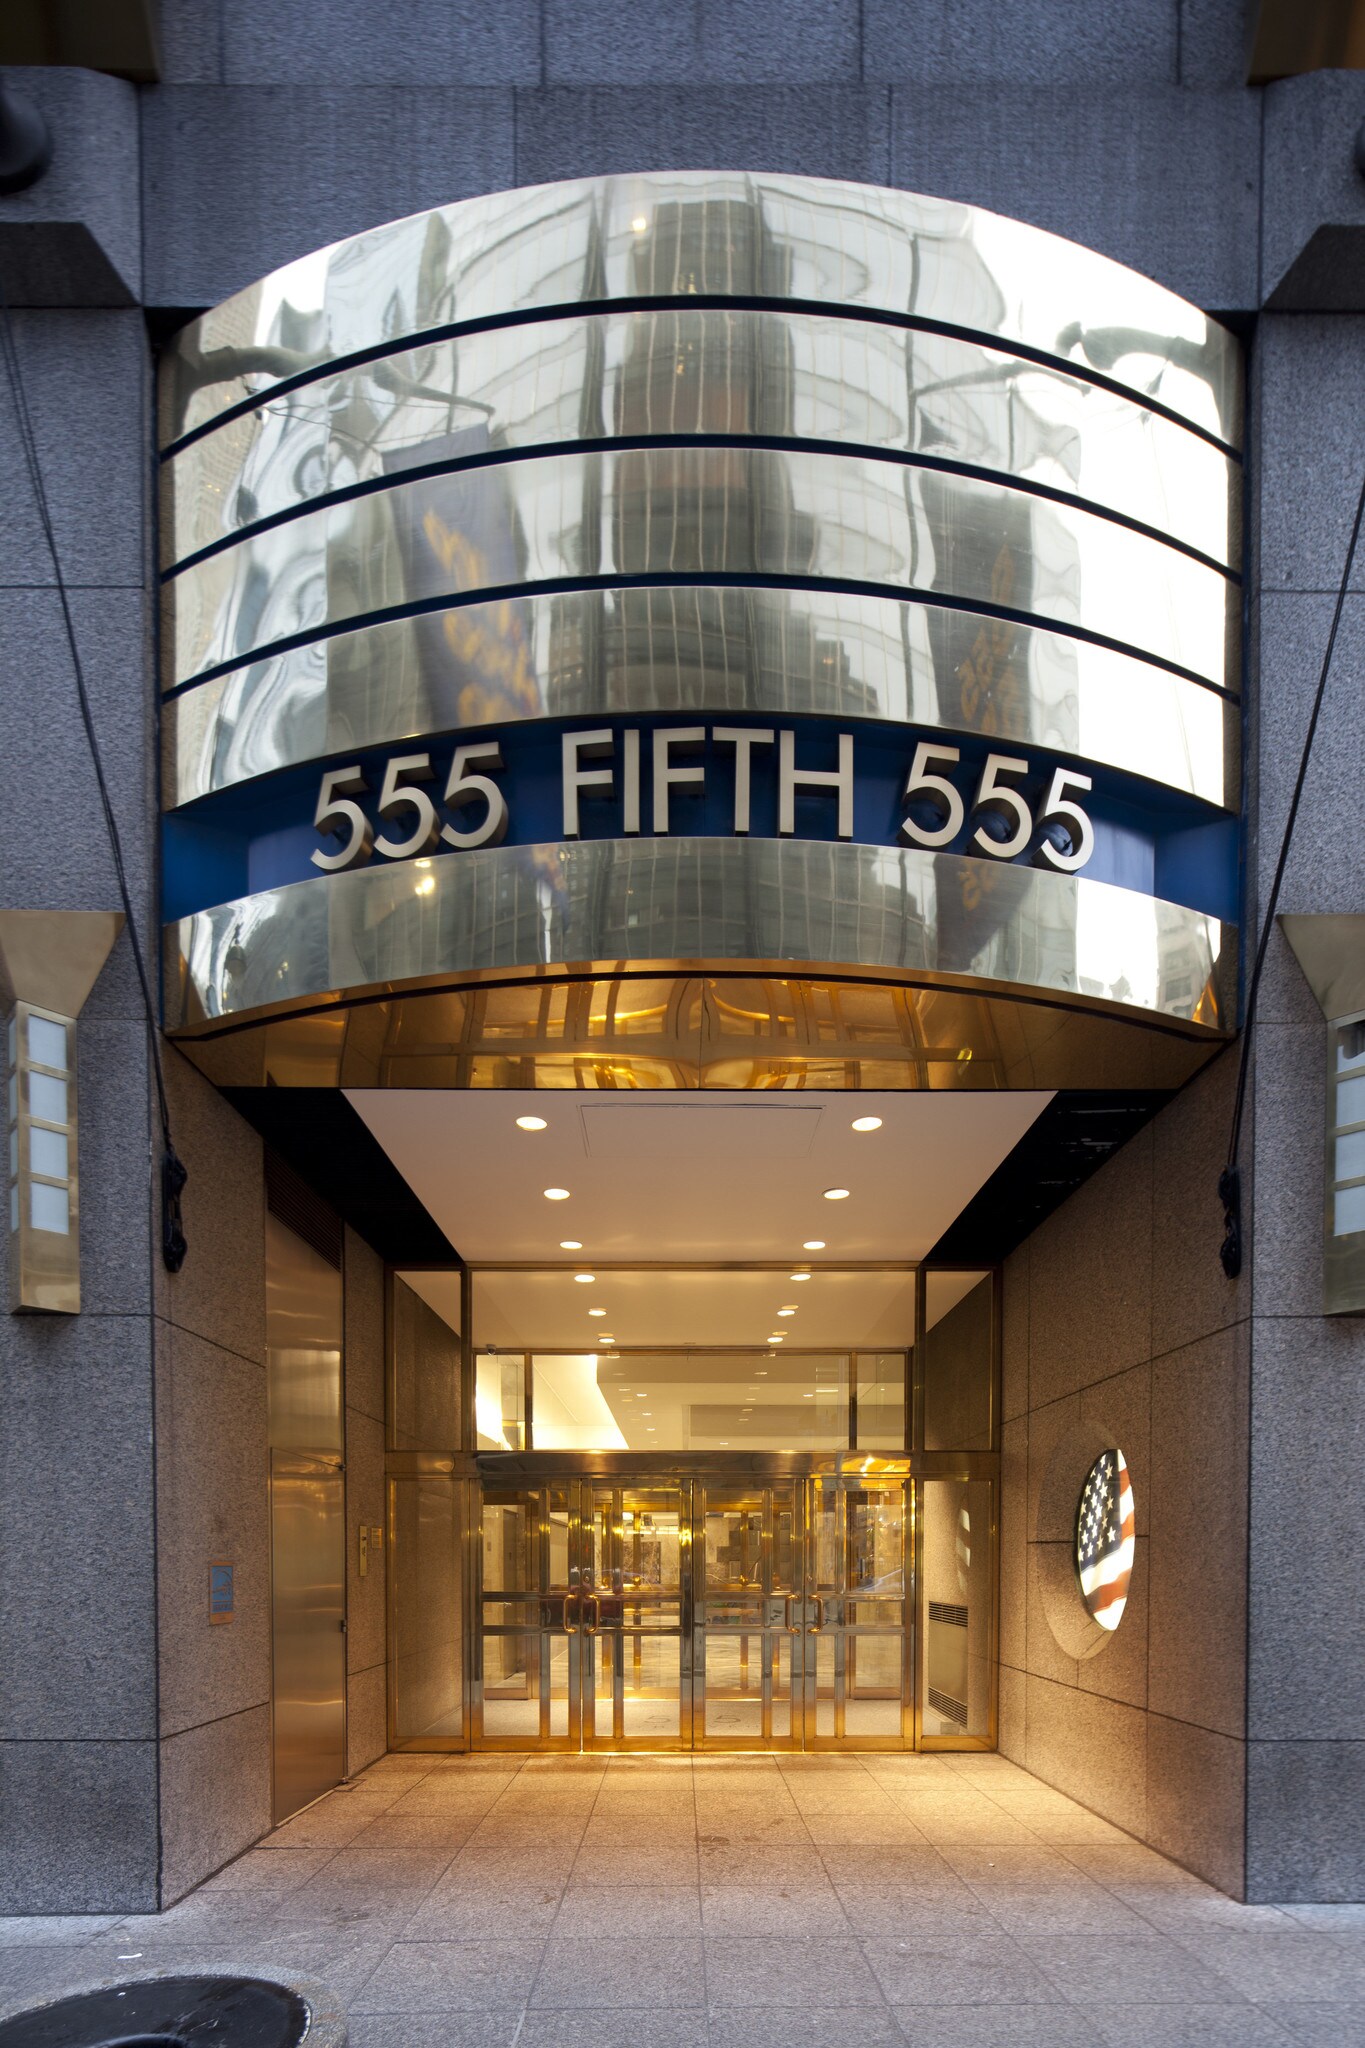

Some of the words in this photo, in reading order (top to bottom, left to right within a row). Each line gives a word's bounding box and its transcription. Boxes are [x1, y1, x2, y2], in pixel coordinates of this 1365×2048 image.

[310, 741, 503, 870] 555
[562, 726, 854, 837] FIFTH
[901, 741, 1095, 871] 555
